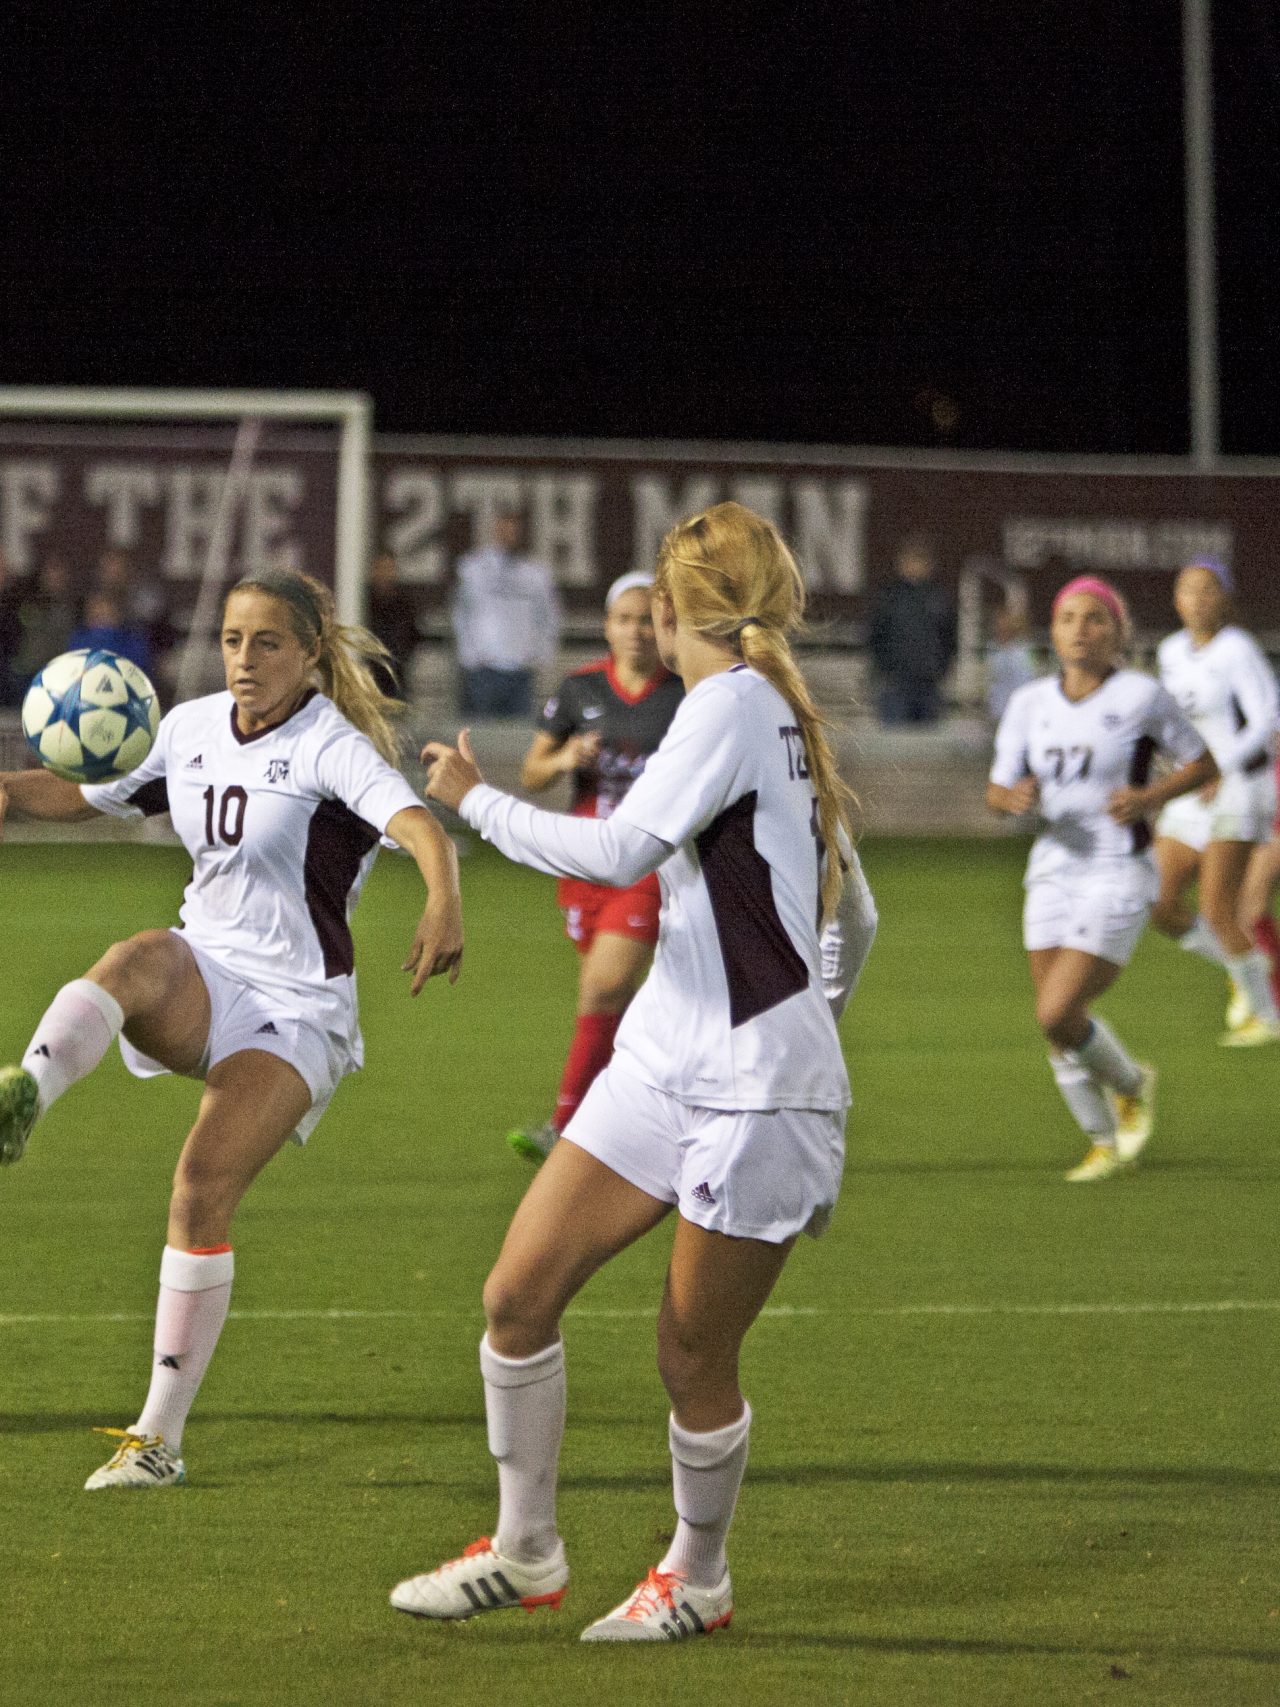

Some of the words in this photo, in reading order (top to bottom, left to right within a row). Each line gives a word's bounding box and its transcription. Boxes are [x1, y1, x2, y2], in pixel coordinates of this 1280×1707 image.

[84, 462, 302, 586] THE
[630, 472, 867, 594] MN
[203, 784, 248, 847] 10
